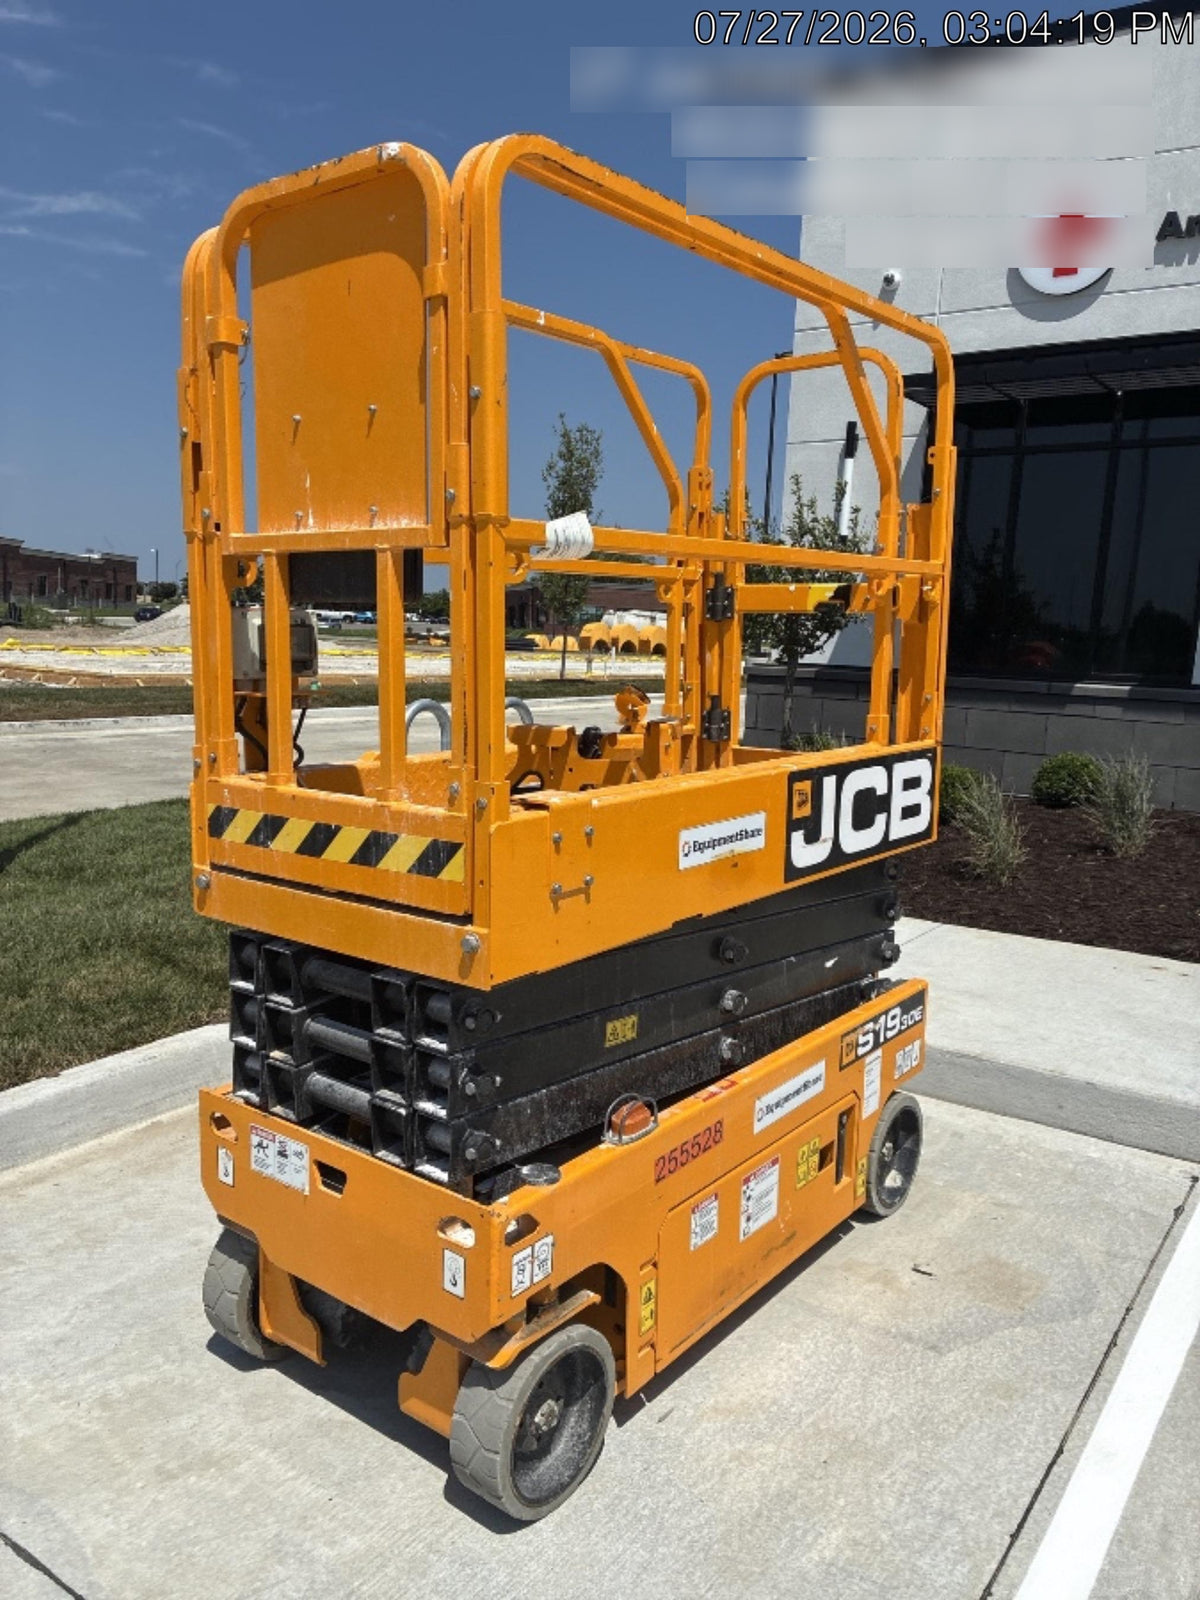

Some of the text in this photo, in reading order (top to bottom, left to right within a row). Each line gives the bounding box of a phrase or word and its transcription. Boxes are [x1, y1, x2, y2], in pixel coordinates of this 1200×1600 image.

[692, 827, 764, 854] EquipmentShare
[790, 758, 933, 869] JCB
[655, 1119, 723, 1184] 255528
